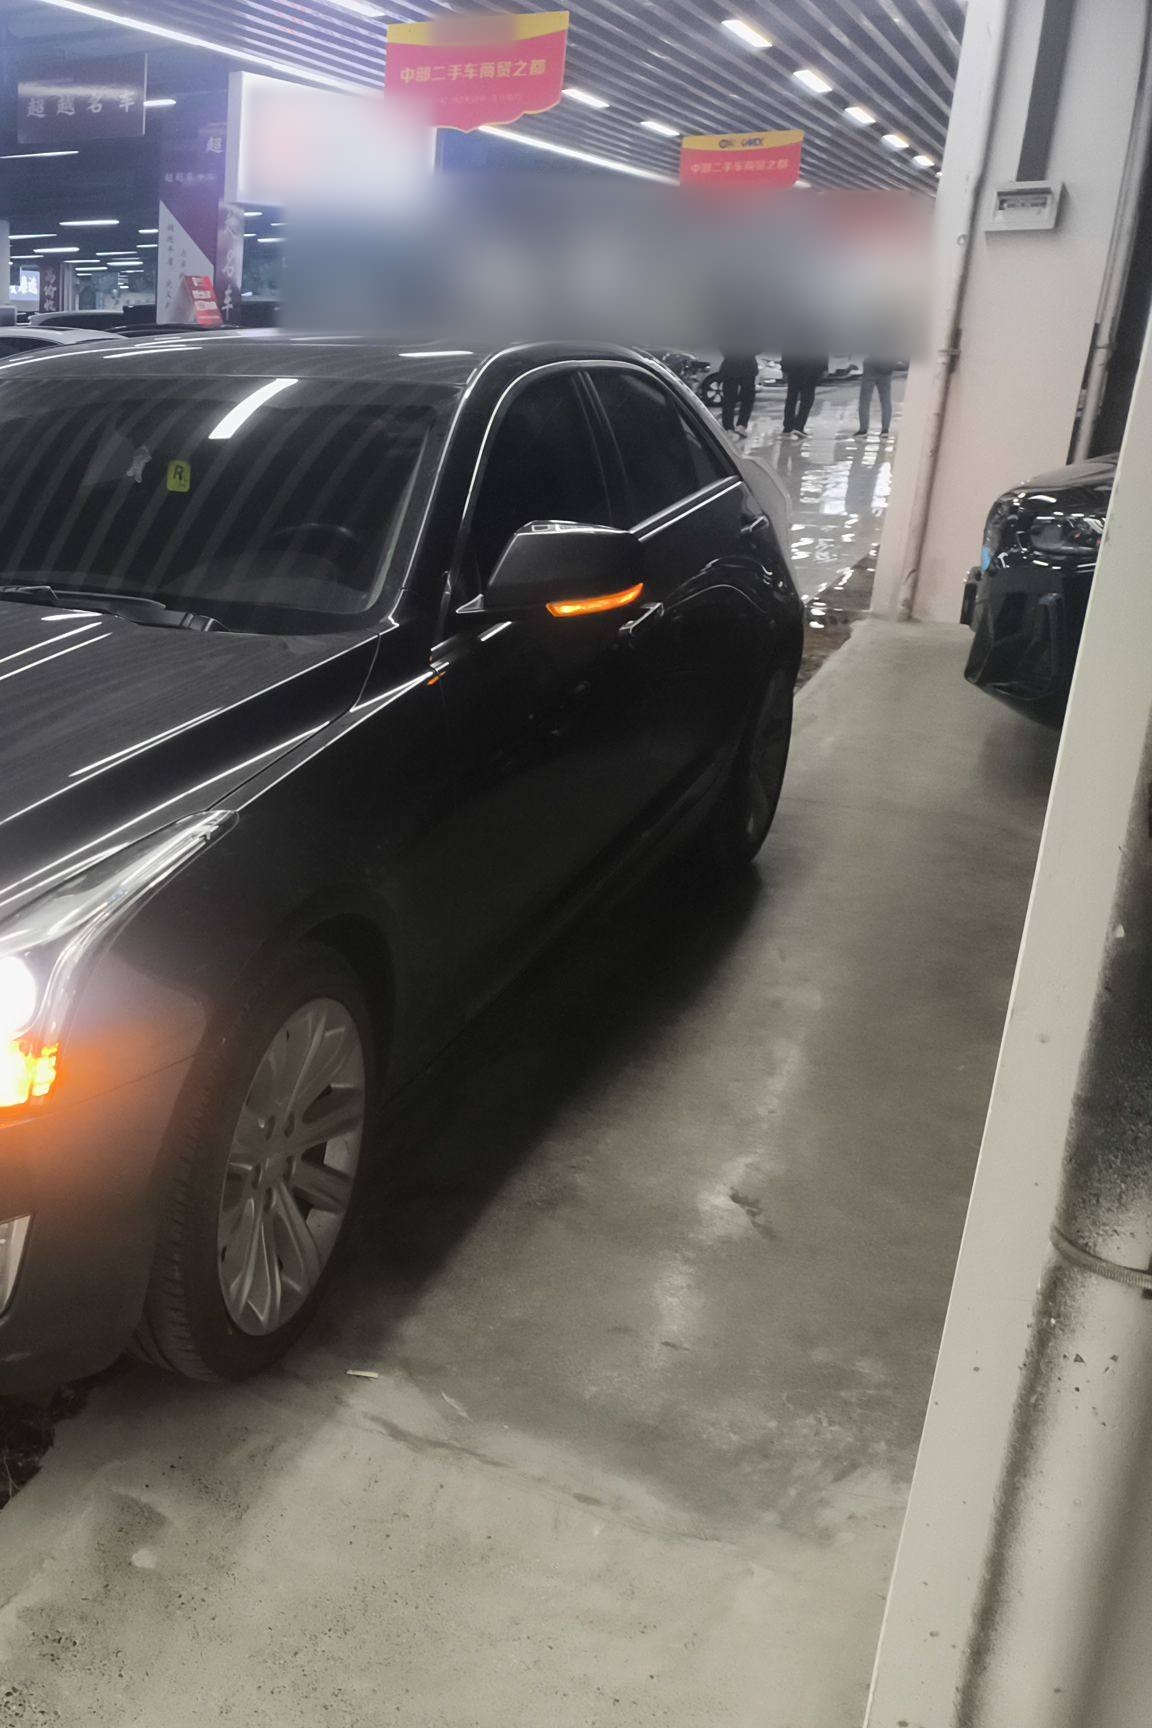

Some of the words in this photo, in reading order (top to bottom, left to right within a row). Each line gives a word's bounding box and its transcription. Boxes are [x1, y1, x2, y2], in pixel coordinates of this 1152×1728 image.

[400, 59, 547, 84] 中部二手车商贸之都
[27, 89, 136, 119] 超越名车
